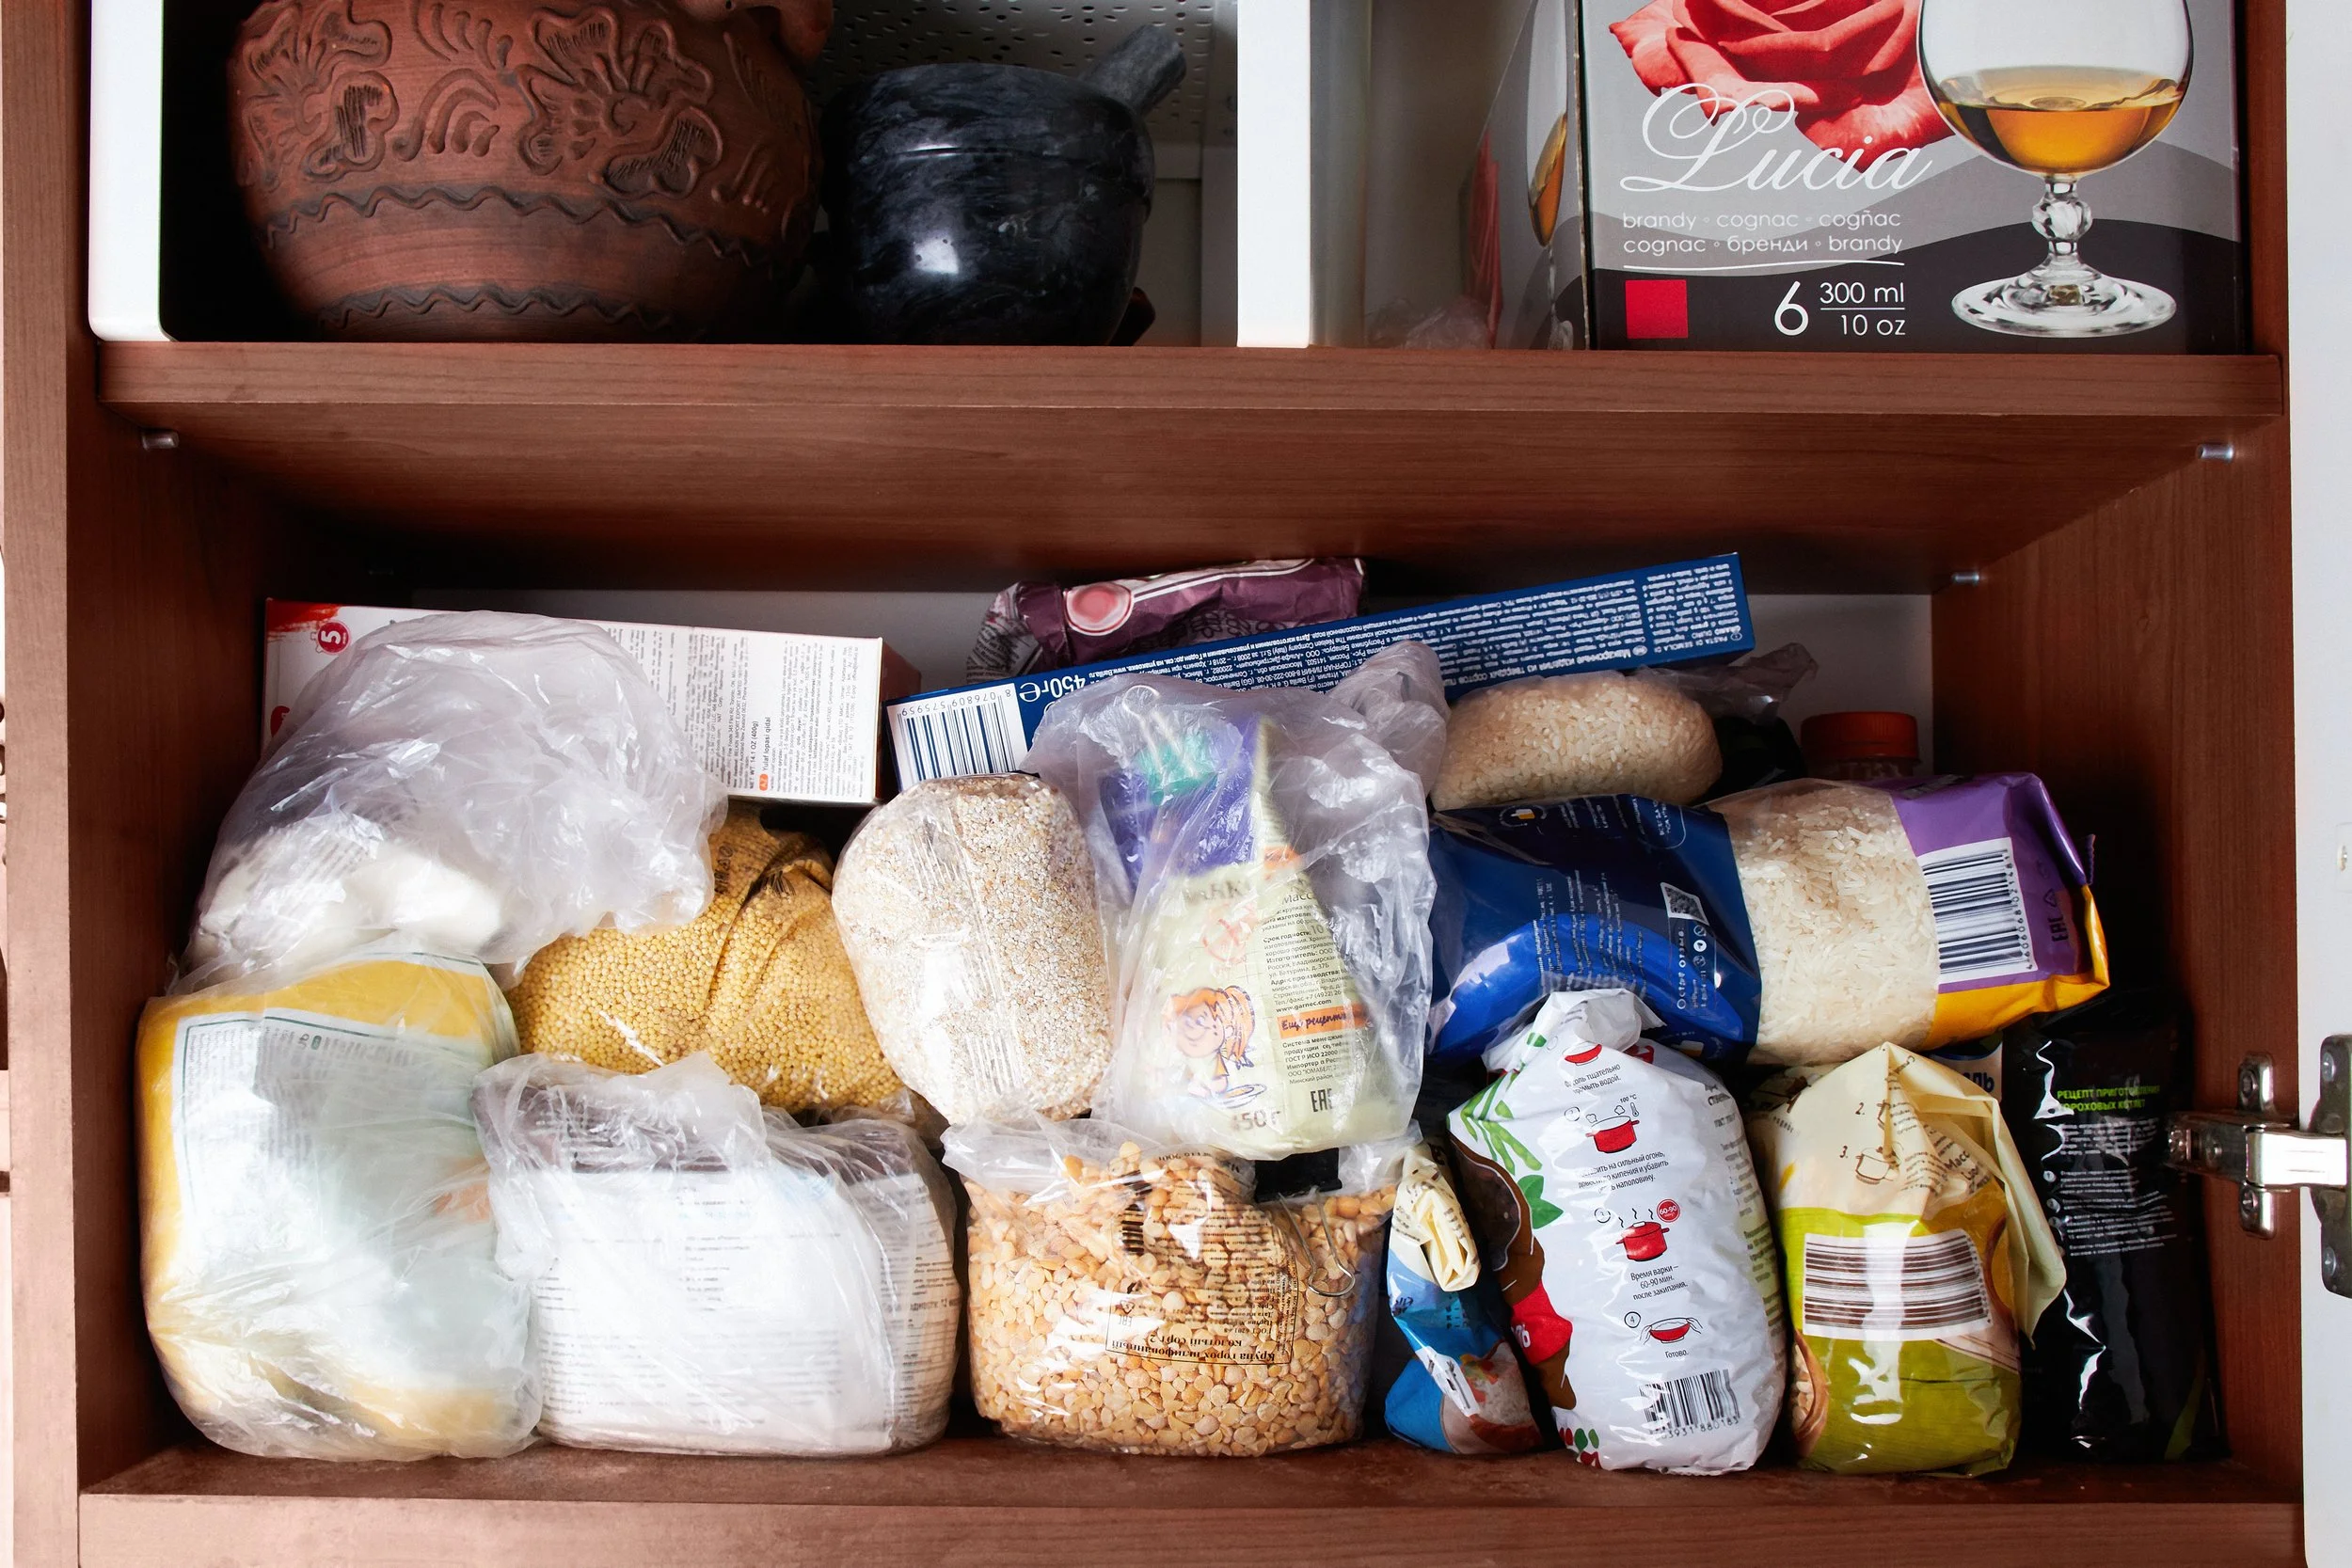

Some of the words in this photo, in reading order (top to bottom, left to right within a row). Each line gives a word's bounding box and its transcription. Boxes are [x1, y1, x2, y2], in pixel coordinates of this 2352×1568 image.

[1620, 83, 1933, 193] Lucia
[1623, 213, 1696, 230] brandy
[1716, 214, 1799, 231] cognac
[1819, 210, 1900, 230] cogñac
[1623, 239, 1707, 256] cognac
[1727, 235, 1808, 255] бренди
[1829, 234, 1902, 253] brandy
[1774, 281, 1809, 336] 6
[1820, 282, 1866, 304] 300
[1875, 282, 1904, 303] ml
[1841, 315, 1867, 335] 10
[1877, 319, 1905, 335] oz
[321, 630, 341, 644] 5
[949, 690, 996, 707] 076809
[1004, 688, 1011, 697] 8
[900, 699, 946, 716] 575959
[1266, 950, 1318, 963] Изготоитель:
[1292, 969, 1340, 982] прозводства:
[1275, 998, 1332, 1013] www.garnec.com
[1585, 1063, 1620, 1082] тщательно
[1599, 1074, 1621, 1086] водой.
[2057, 1089, 2094, 1100] РЕЦЕПТ
[2060, 1101, 2116, 1112] ОРОХОВЫХ
[1615, 1153, 1645, 1168] сильный
[1645, 1149, 1665, 1161] огонь,
[1643, 1158, 1669, 1173] убавить
[1615, 1173, 1656, 1189] наполовину.
[1658, 1204, 1677, 1215] 60-90
[1629, 1269, 1653, 1281] Время
[1652, 1264, 1673, 1276] варки
[1639, 1277, 1659, 1289] 60-90
[1659, 1274, 1675, 1284] мин.
[1632, 1290, 1653, 1300] после
[1652, 1280, 1689, 1296] закипания.
[1664, 1347, 1689, 1359] Готово.
